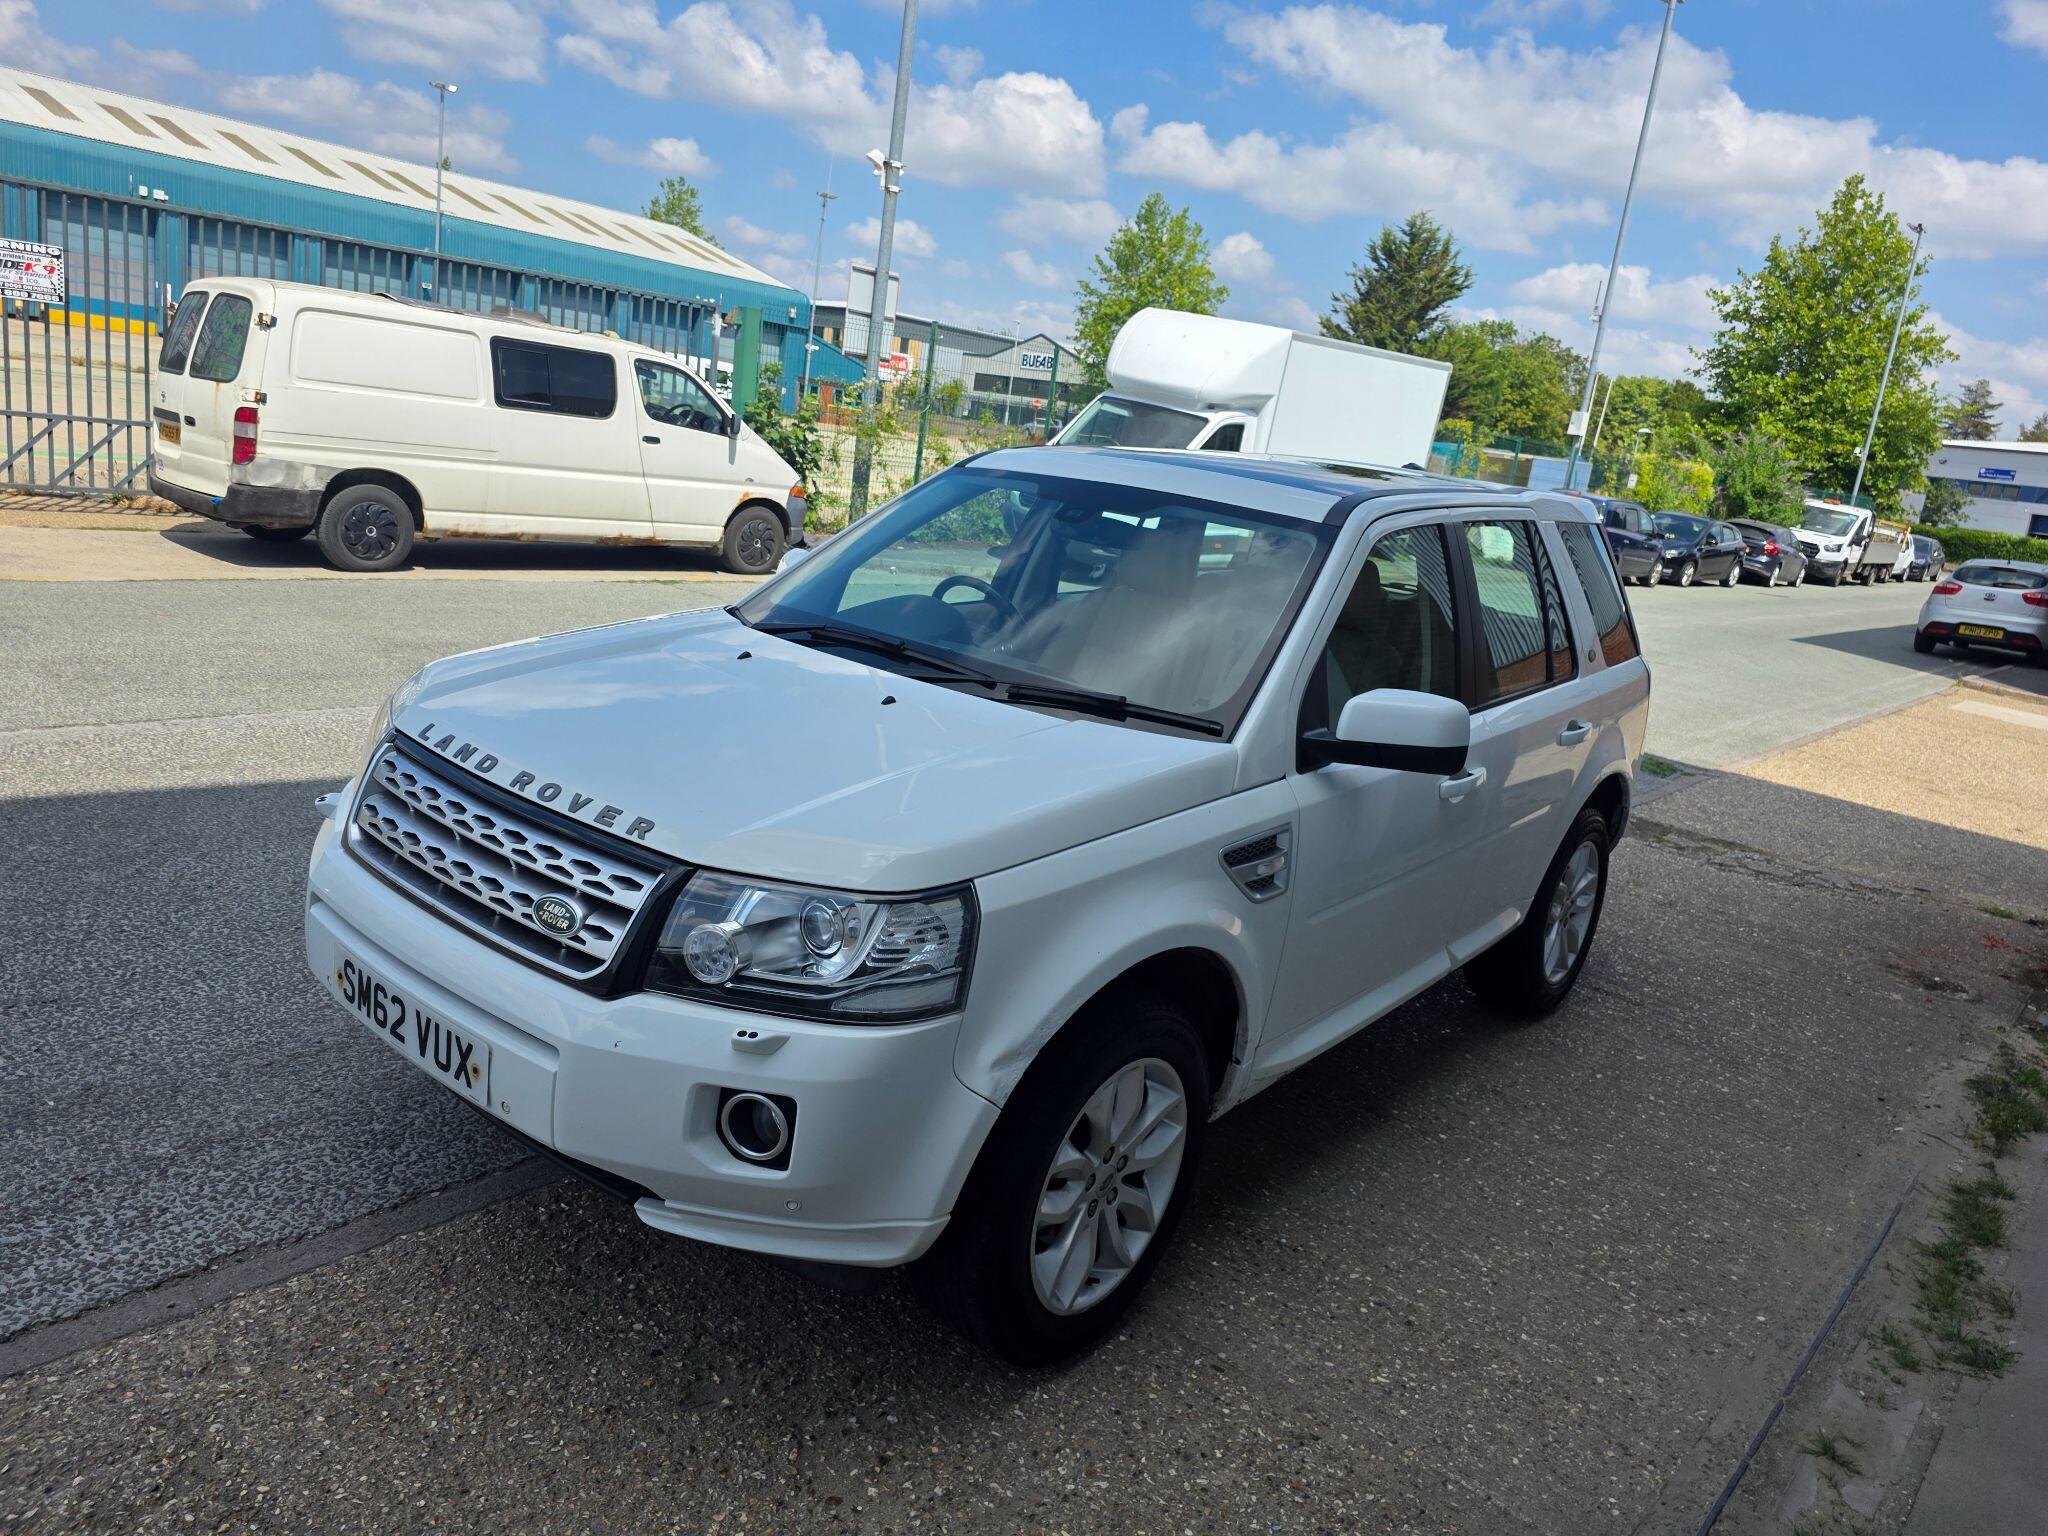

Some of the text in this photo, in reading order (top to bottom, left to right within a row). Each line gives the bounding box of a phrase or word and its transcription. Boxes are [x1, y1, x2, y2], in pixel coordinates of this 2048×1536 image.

[417, 723, 656, 841] LAND ROVER
[541, 910, 570, 930] ROVER
[543, 901, 566, 917] LAND
[343, 958, 474, 1090] SM62 VUX
